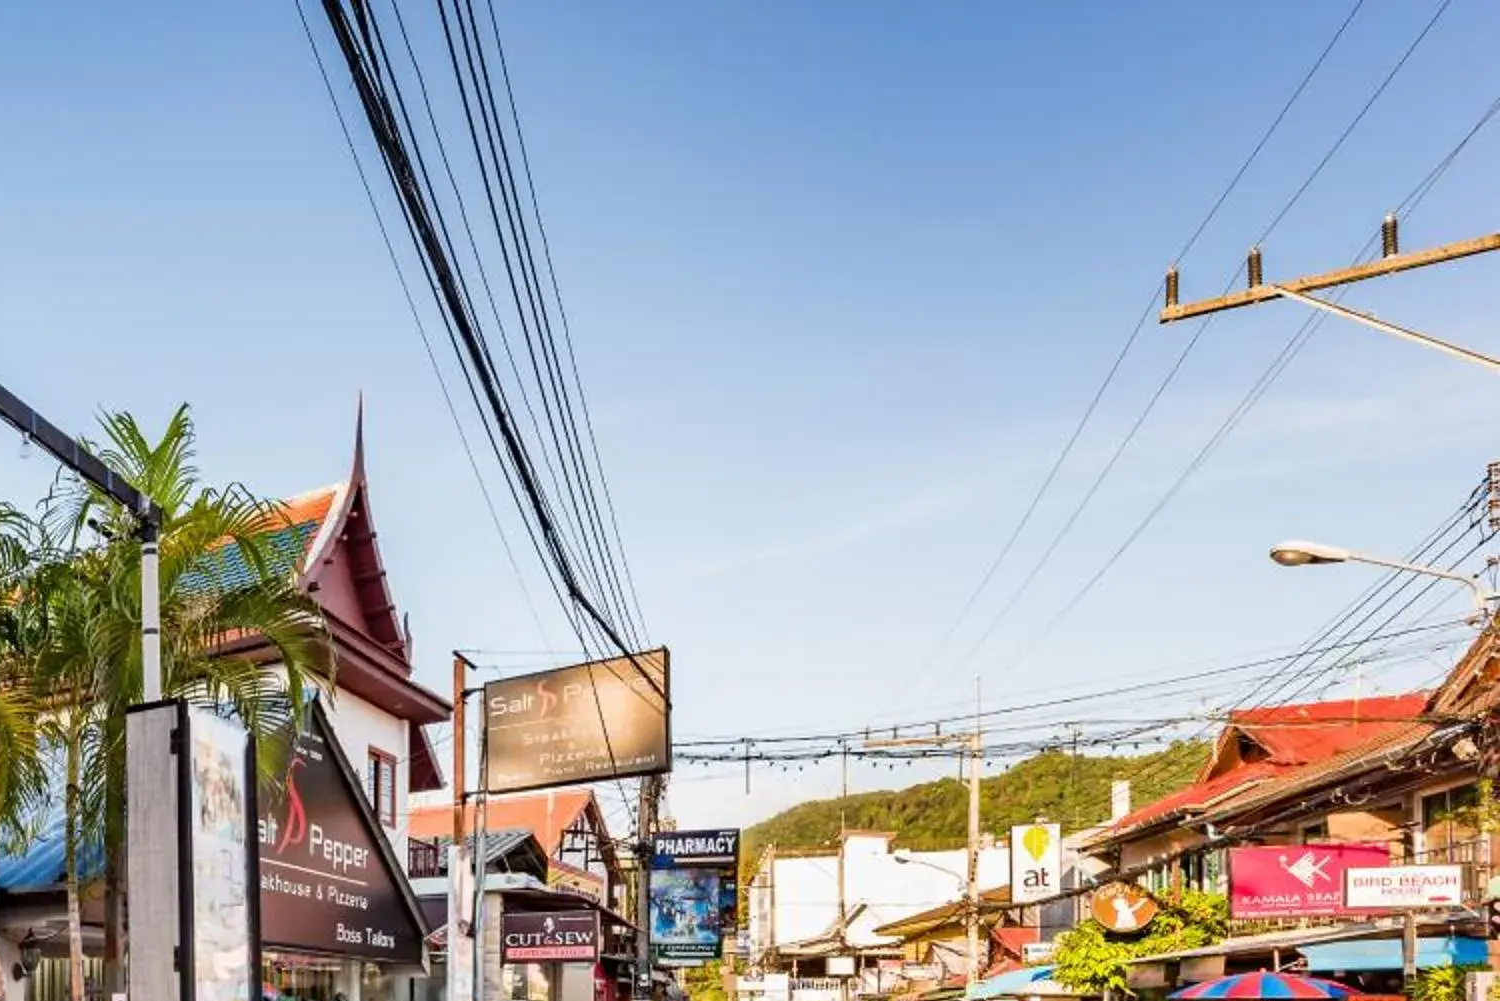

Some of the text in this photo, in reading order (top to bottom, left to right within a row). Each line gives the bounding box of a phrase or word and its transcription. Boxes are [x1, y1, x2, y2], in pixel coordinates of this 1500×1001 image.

[257, 812, 369, 874] alt Pepper
[656, 837, 736, 855] PHARMACY
[1024, 867, 1050, 887] at
[328, 886, 369, 910] Pizzeria
[336, 922, 362, 944] Boss
[505, 932, 544, 947] CUT
[555, 931, 593, 945] SEW
